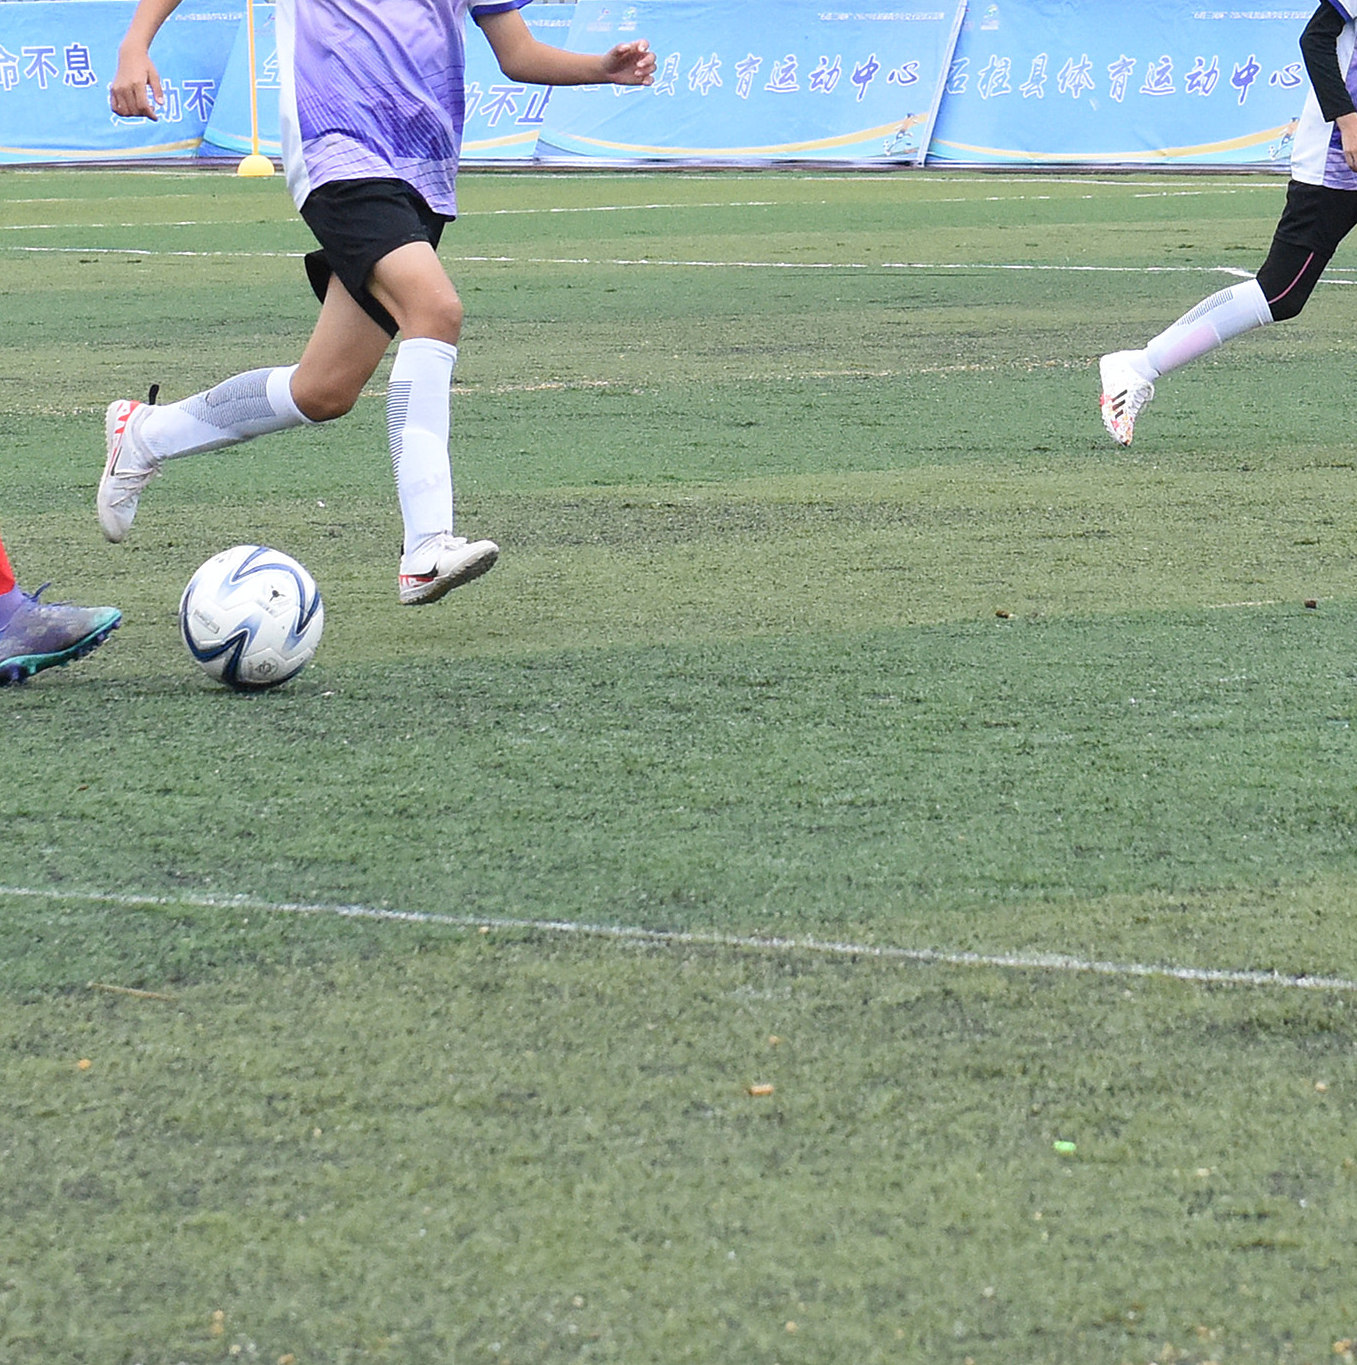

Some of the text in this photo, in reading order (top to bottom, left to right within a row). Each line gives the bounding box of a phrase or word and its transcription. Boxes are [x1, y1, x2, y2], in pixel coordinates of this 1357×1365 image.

[573, 52, 920, 102] 县体育运动中心
